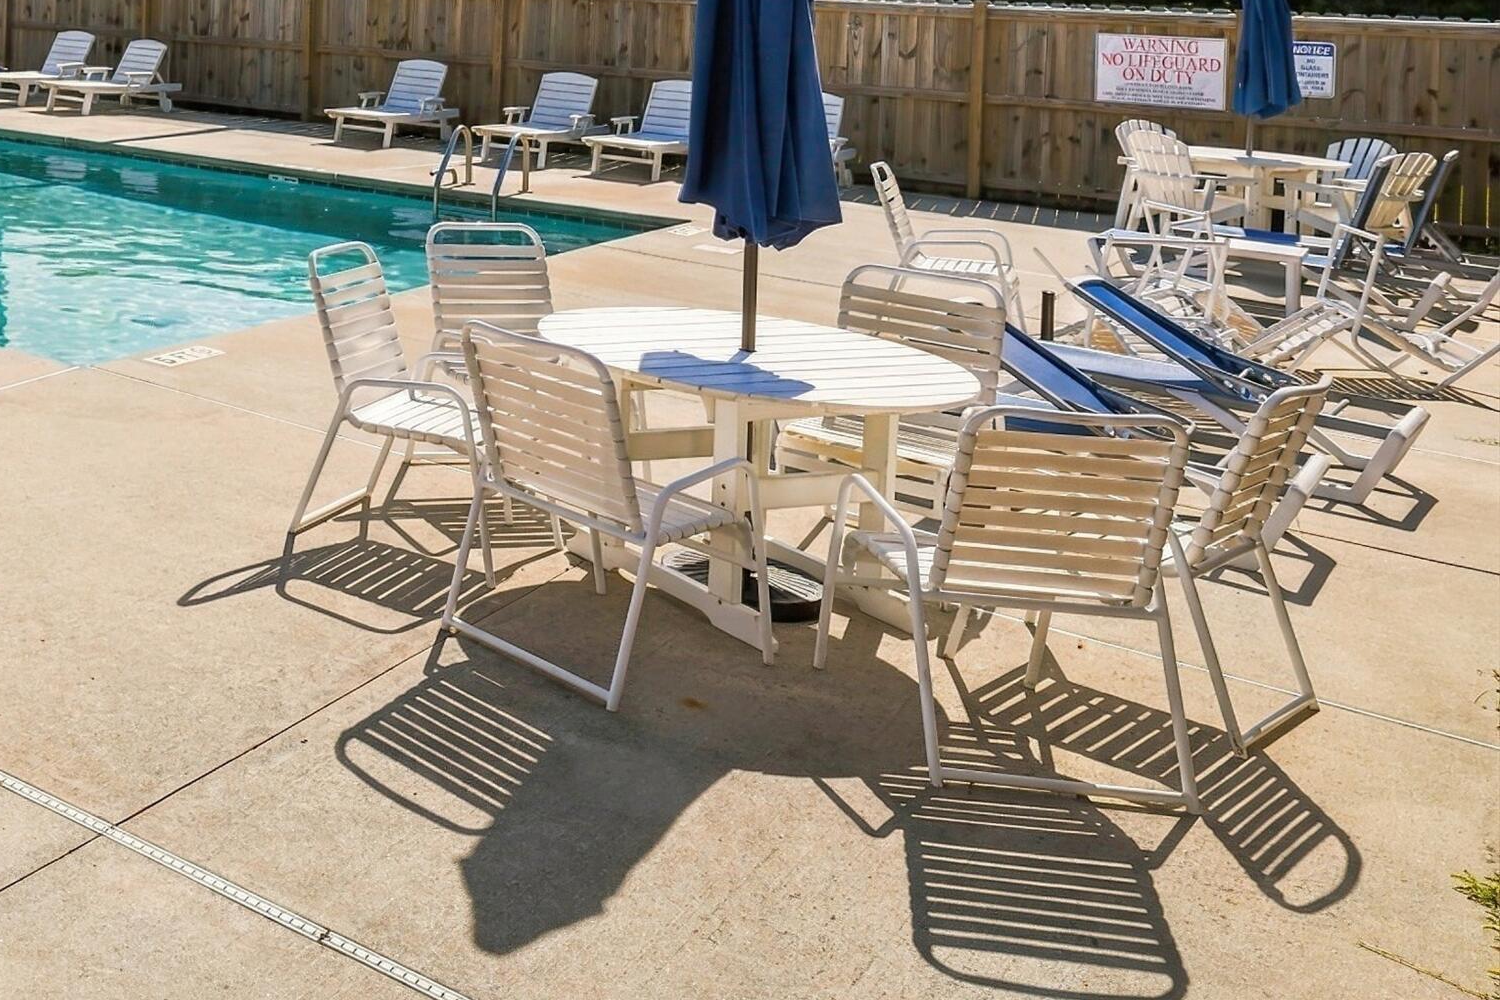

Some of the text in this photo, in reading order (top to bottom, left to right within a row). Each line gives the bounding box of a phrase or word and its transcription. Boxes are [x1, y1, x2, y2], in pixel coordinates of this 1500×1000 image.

[1123, 38, 1198, 54] WARNING
[1293, 45, 1330, 55] NOTICE
[1102, 53, 1221, 72] NO LIFEGUARD
[1123, 67, 1195, 84] ON DUTY
